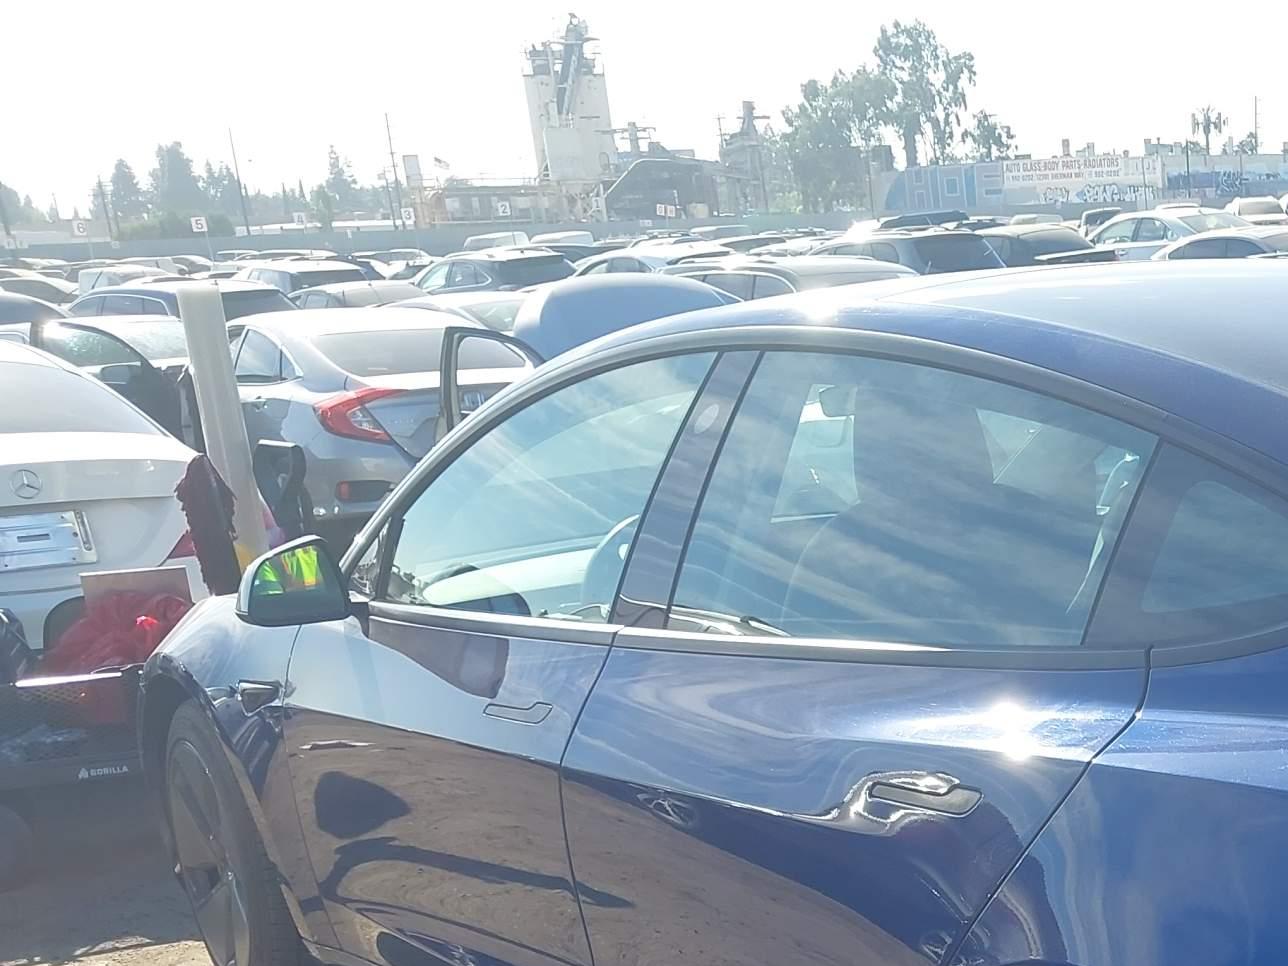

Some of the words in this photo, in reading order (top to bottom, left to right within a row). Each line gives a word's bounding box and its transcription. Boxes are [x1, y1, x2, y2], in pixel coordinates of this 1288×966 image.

[500, 204, 508, 214] 2
[405, 210, 411, 220] 3
[77, 222, 86, 233] 6
[195, 219, 204, 230] 5
[90, 765, 129, 777] GORILLA
